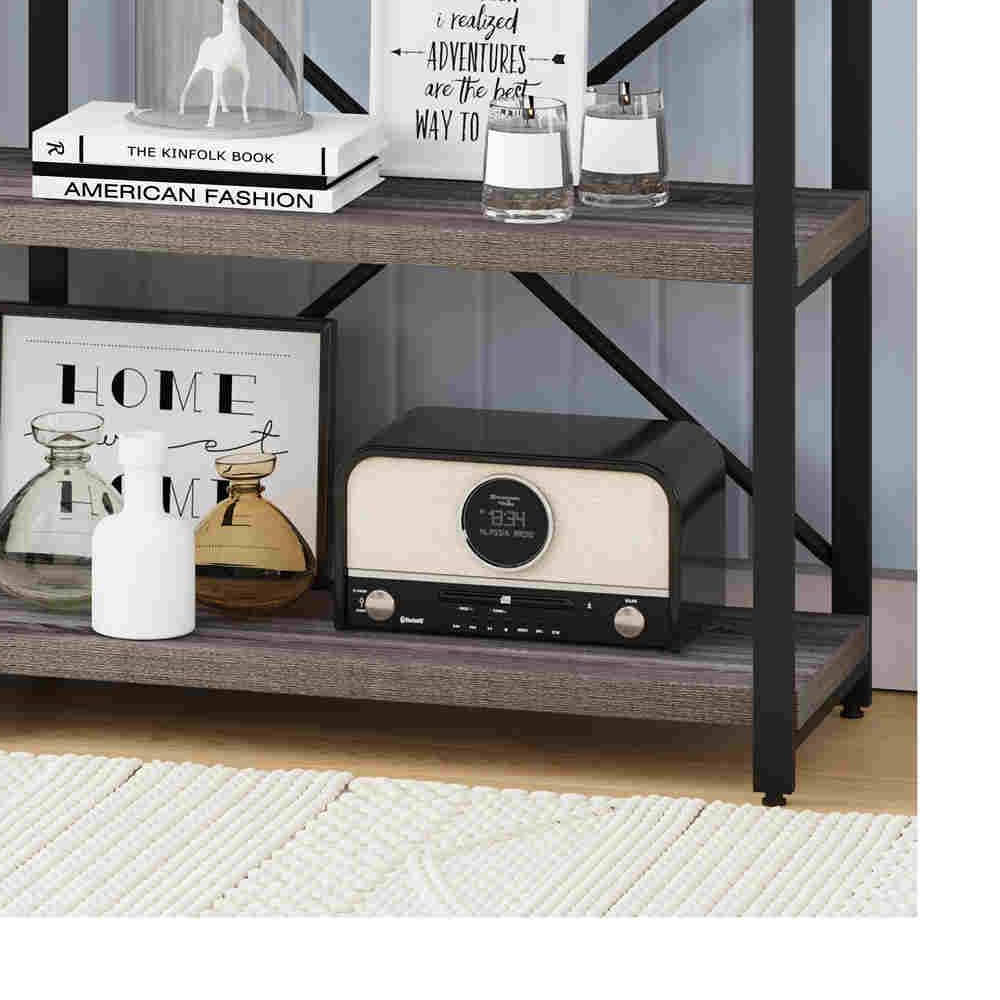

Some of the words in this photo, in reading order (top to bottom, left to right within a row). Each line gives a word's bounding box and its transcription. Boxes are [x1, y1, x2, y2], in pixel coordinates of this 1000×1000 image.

[450, 3, 519, 41] realized
[426, 41, 527, 75] ADVENTURES
[424, 82, 455, 99] are
[452, 75, 488, 105] the
[494, 77, 543, 101] best
[415, 108, 453, 142] WAY
[460, 111, 480, 142] TO
[46, 141, 65, 156] R
[127, 145, 157, 158] THE
[161, 147, 227, 162] KINFOLK
[232, 151, 275, 165] BOOK
[63, 182, 196, 203] AMERICAN
[205, 188, 314, 209] FASHION
[55, 363, 257, 417] HOME
